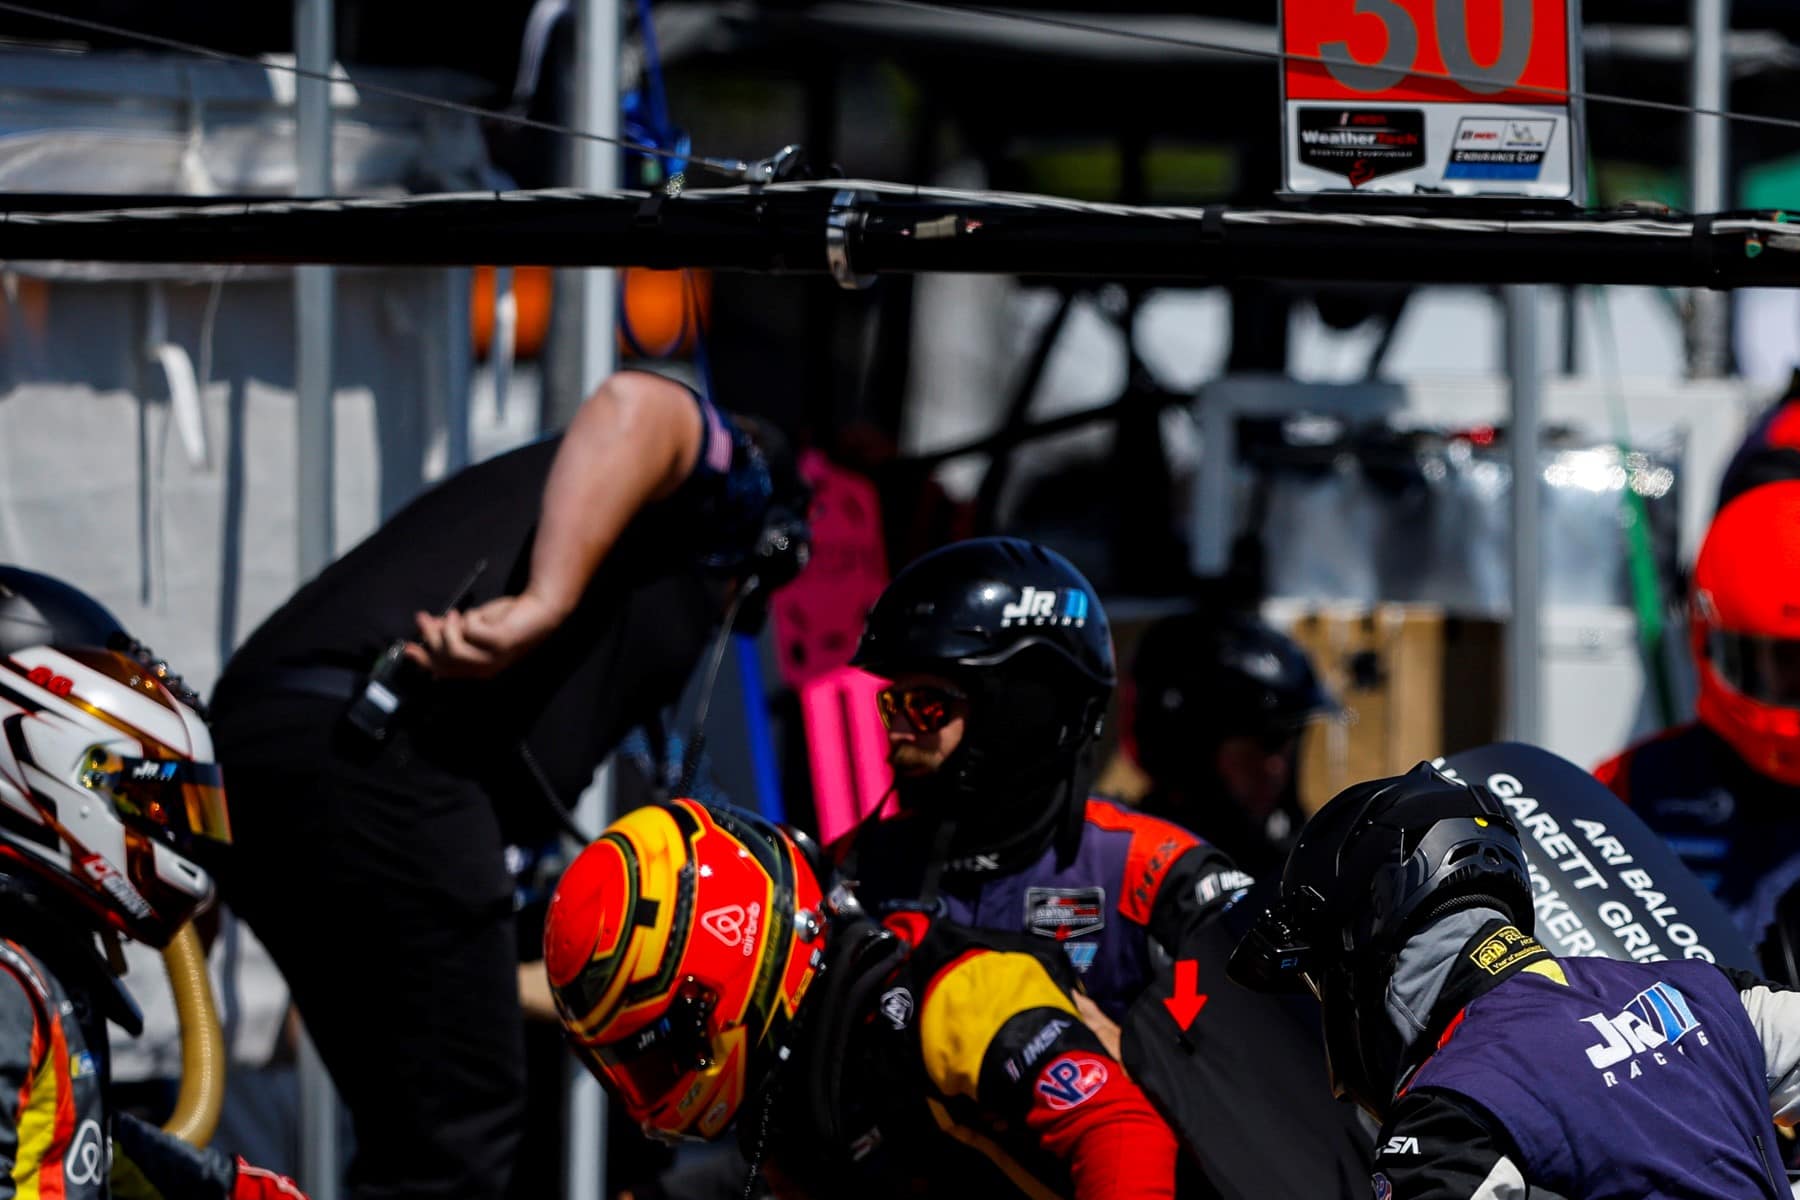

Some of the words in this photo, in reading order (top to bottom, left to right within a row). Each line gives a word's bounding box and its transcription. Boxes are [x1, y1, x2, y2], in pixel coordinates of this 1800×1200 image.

[1318, 0, 1534, 95] 30
[1487, 773, 1608, 889] GARETT
[1598, 901, 1670, 963] GRI
[1572, 818, 1633, 866] ARI
